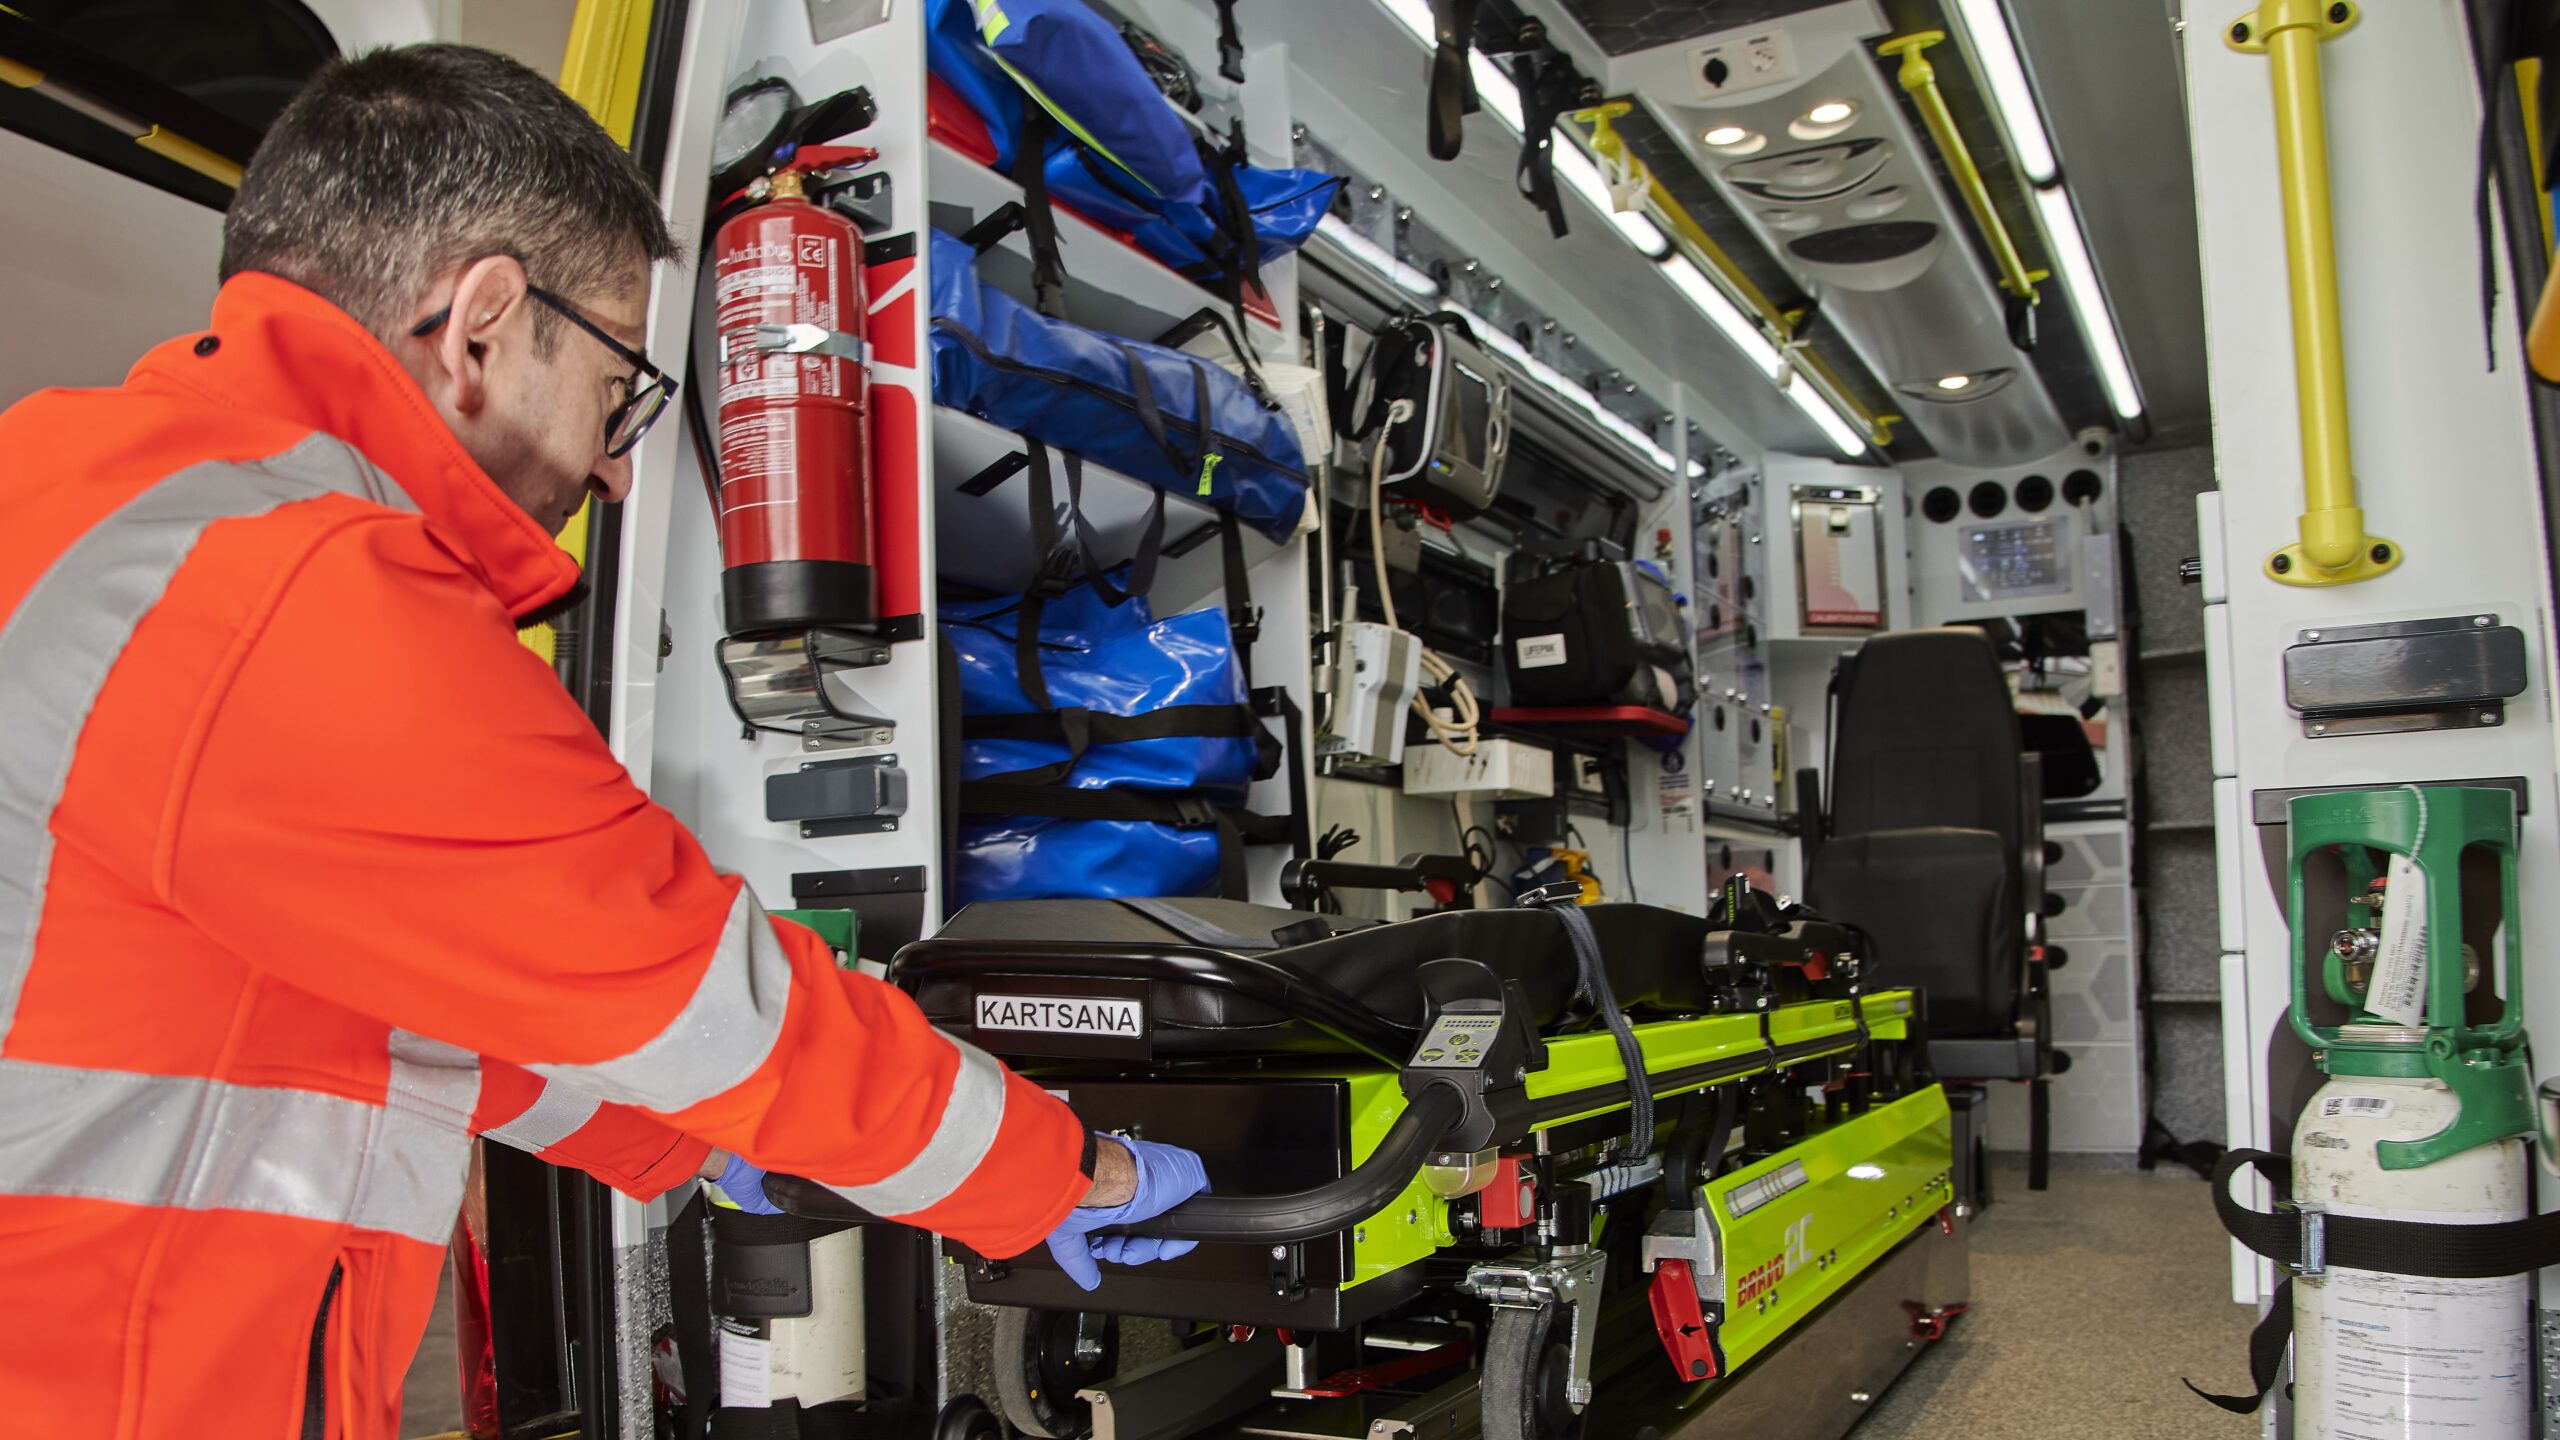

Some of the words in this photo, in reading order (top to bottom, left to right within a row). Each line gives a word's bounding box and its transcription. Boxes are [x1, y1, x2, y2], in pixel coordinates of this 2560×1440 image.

[982, 1001, 1136, 1031] KARTSANA
[1737, 1253, 1784, 1309] BRAVO
[1784, 1211, 1814, 1276] 2C
